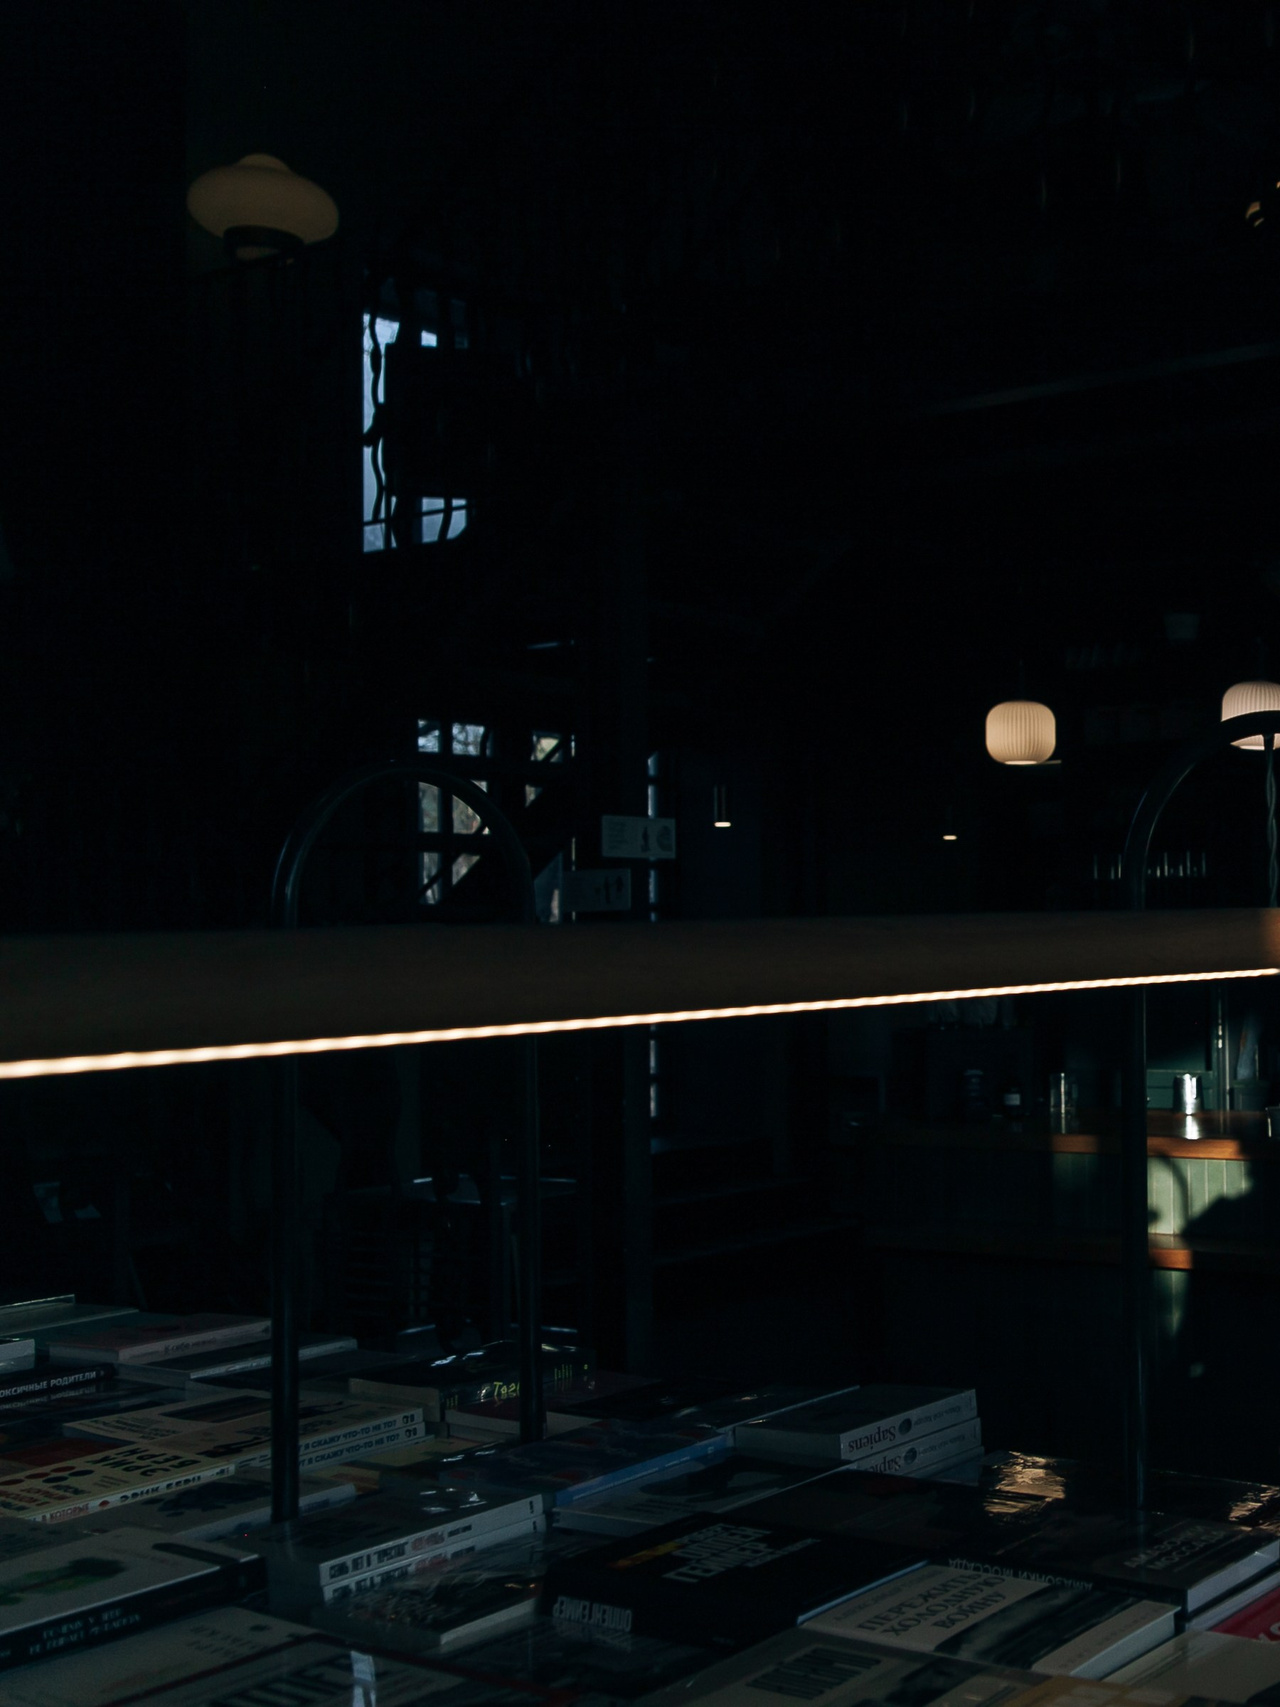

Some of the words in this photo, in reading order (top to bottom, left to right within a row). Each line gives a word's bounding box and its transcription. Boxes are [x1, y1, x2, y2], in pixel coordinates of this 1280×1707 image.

[0, 1381, 48, 1398] ОКСИЧНЫЕ
[50, 1370, 97, 1388] РОДИТЕЛИ
[311, 1434, 342, 1449] СКАЖУ
[342, 1426, 371, 1439] ЧТО-ТО
[372, 1423, 382, 1432] НЕ
[383, 1419, 397, 1430] ТО?
[314, 1448, 345, 1463] СКАЖУ
[345, 1439, 374, 1454] ЧТО-ТО
[375, 1436, 385, 1446] НЕ
[386, 1432, 400, 1443] ТО?
[848, 1425, 897, 1453] Sapiens
[86, 1455, 170, 1477] ЭРИК
[115, 1448, 201, 1469] БЕРН
[866, 1455, 902, 1475] Sapie
[947, 1557, 1013, 1577] МОССАДА
[1017, 1567, 1093, 1591] АМАЗОНКИ
[857, 1572, 982, 1631] ПЕРЕЖИТЬ
[879, 1575, 1006, 1636] ХОЛОДНУЮ
[930, 1590, 1007, 1629] ВОЙНУ
